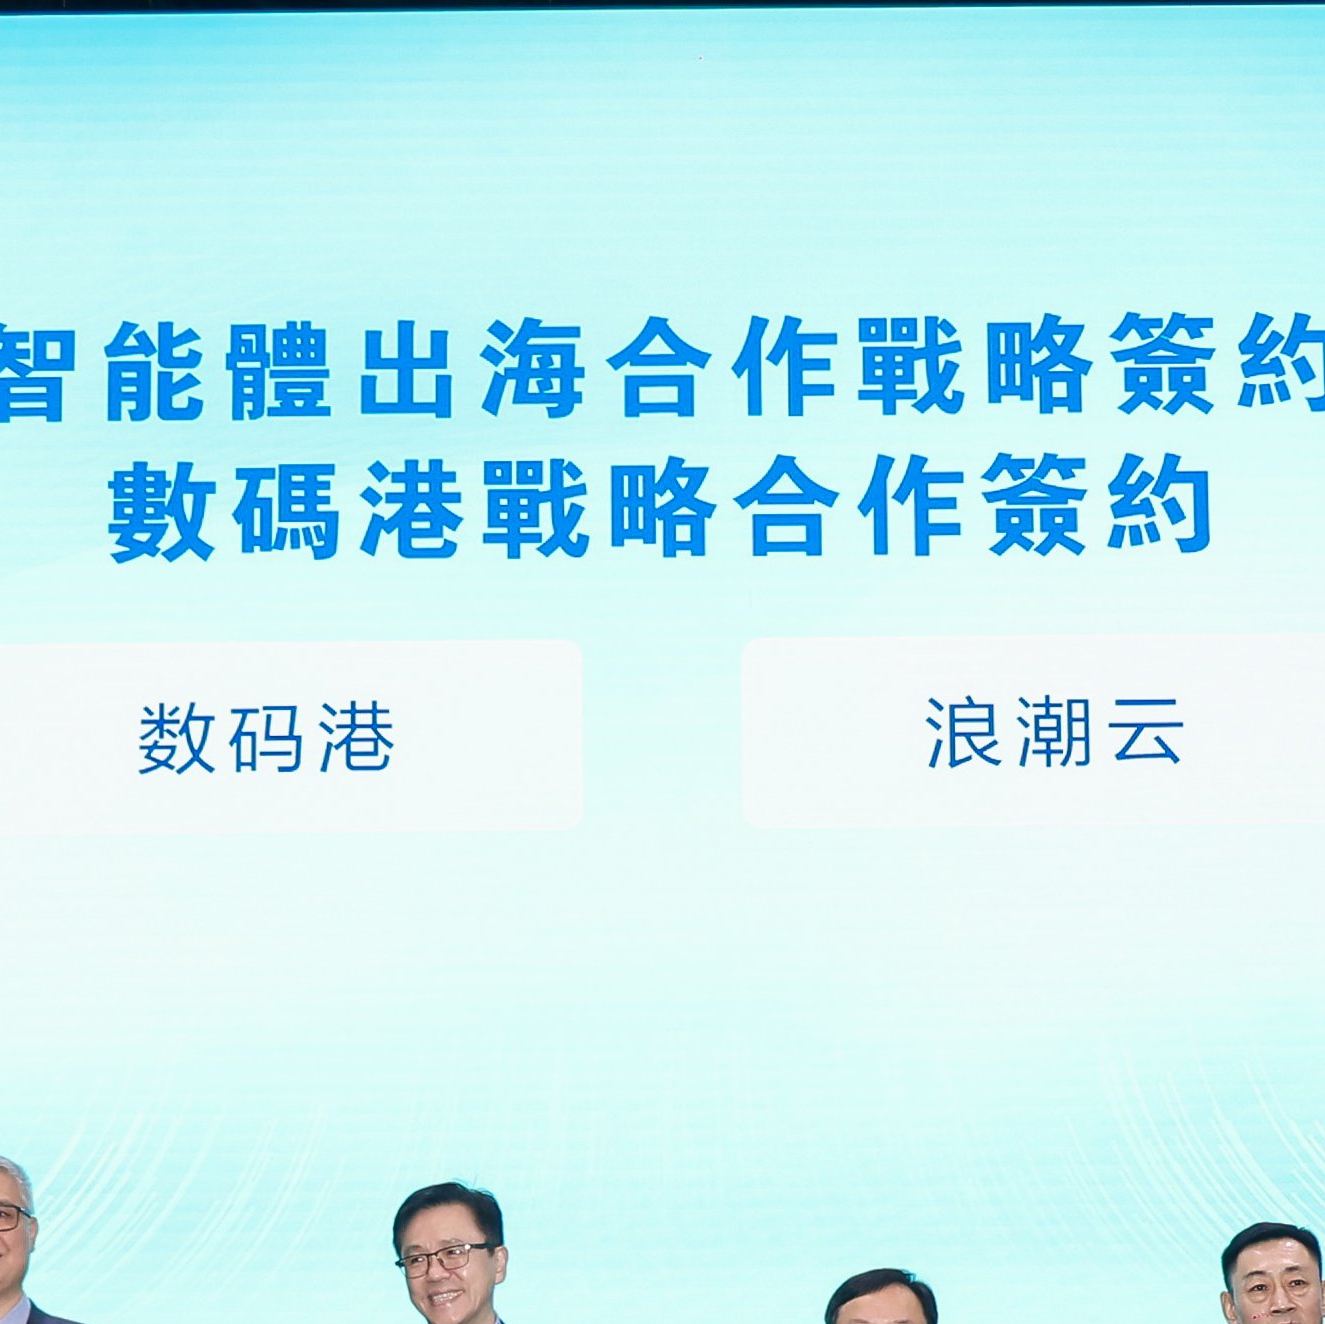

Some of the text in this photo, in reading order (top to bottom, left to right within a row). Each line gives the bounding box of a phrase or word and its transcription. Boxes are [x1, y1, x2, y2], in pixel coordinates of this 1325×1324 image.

[108, 453, 1210, 563] 數碼港戰略合作簽約
[138, 701, 394, 775] 数码港
[925, 695, 1184, 769] 浪潮云
